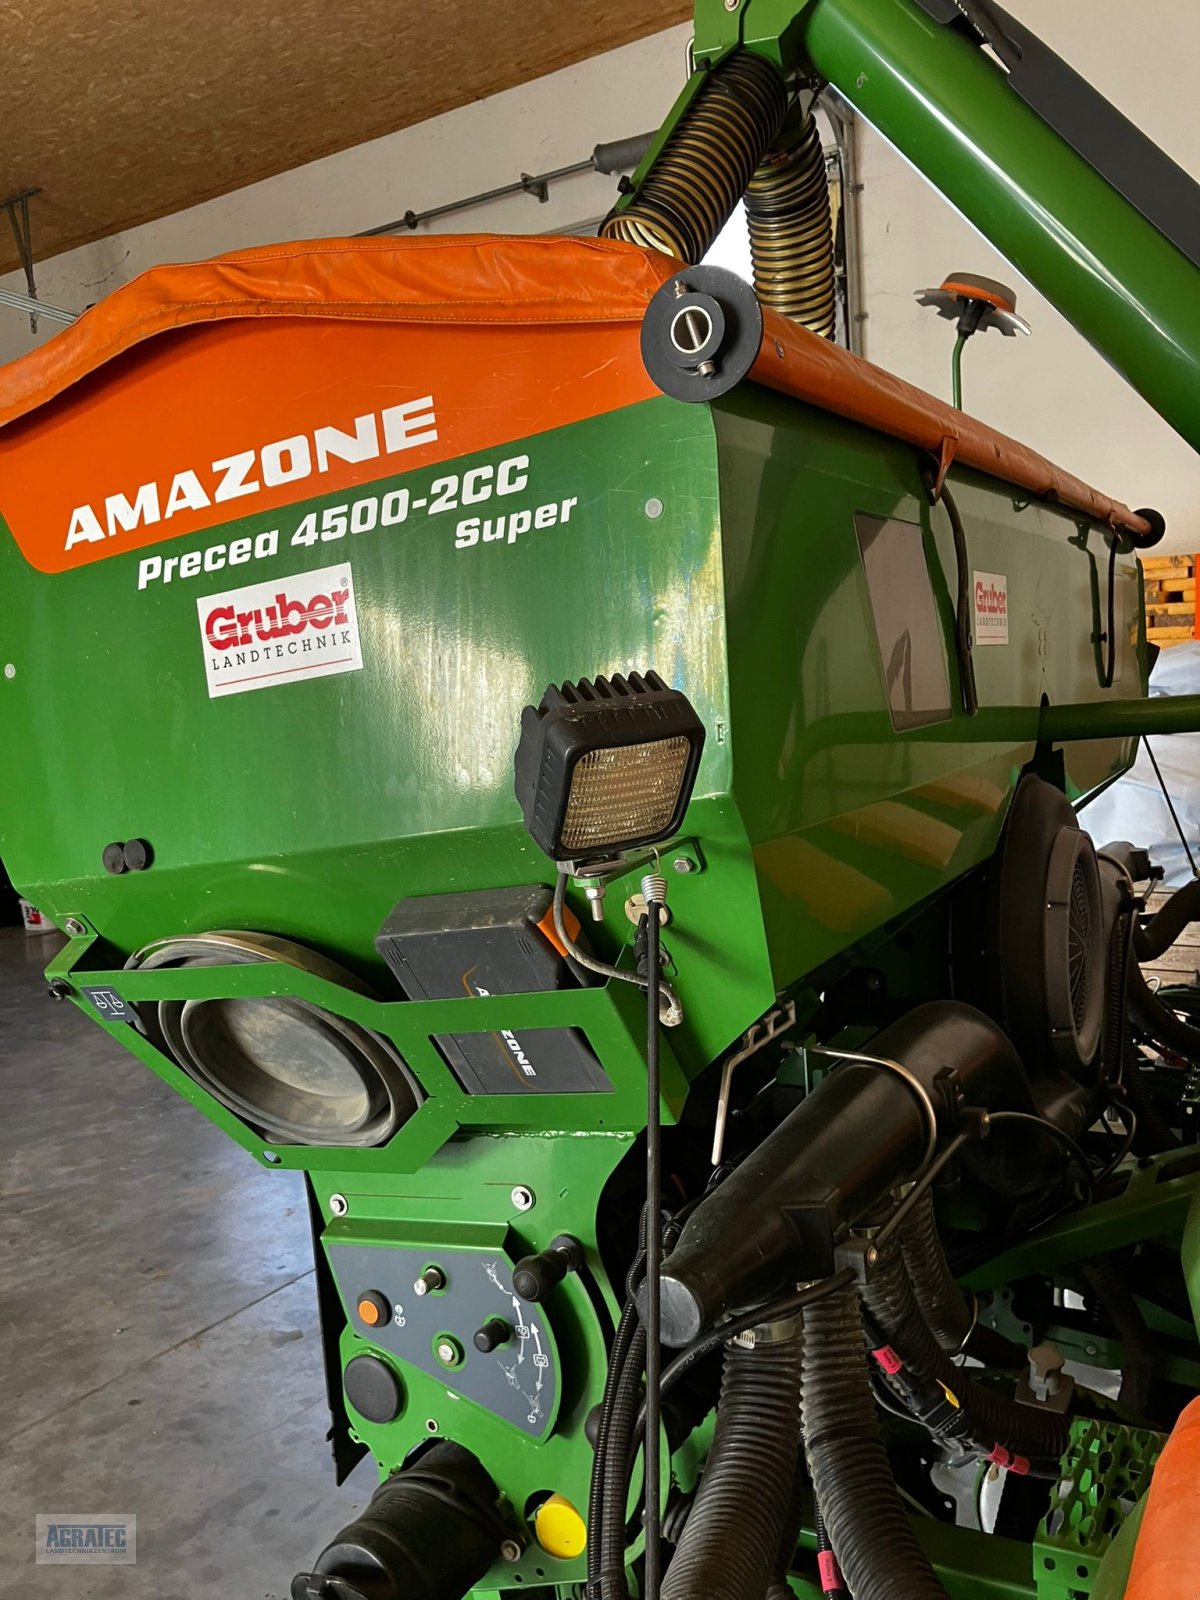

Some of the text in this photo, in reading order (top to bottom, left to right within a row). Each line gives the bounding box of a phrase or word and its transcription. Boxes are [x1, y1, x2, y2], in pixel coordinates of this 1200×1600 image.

[64, 395, 438, 550] AMAZONE
[137, 454, 530, 591] Precea 4500-2CC
[454, 496, 578, 549] Super
[205, 588, 350, 650] Gruber
[976, 581, 1006, 614] Gruber
[212, 631, 351, 670] LANDTECHNIK
[477, 987, 536, 1076] AZONE
